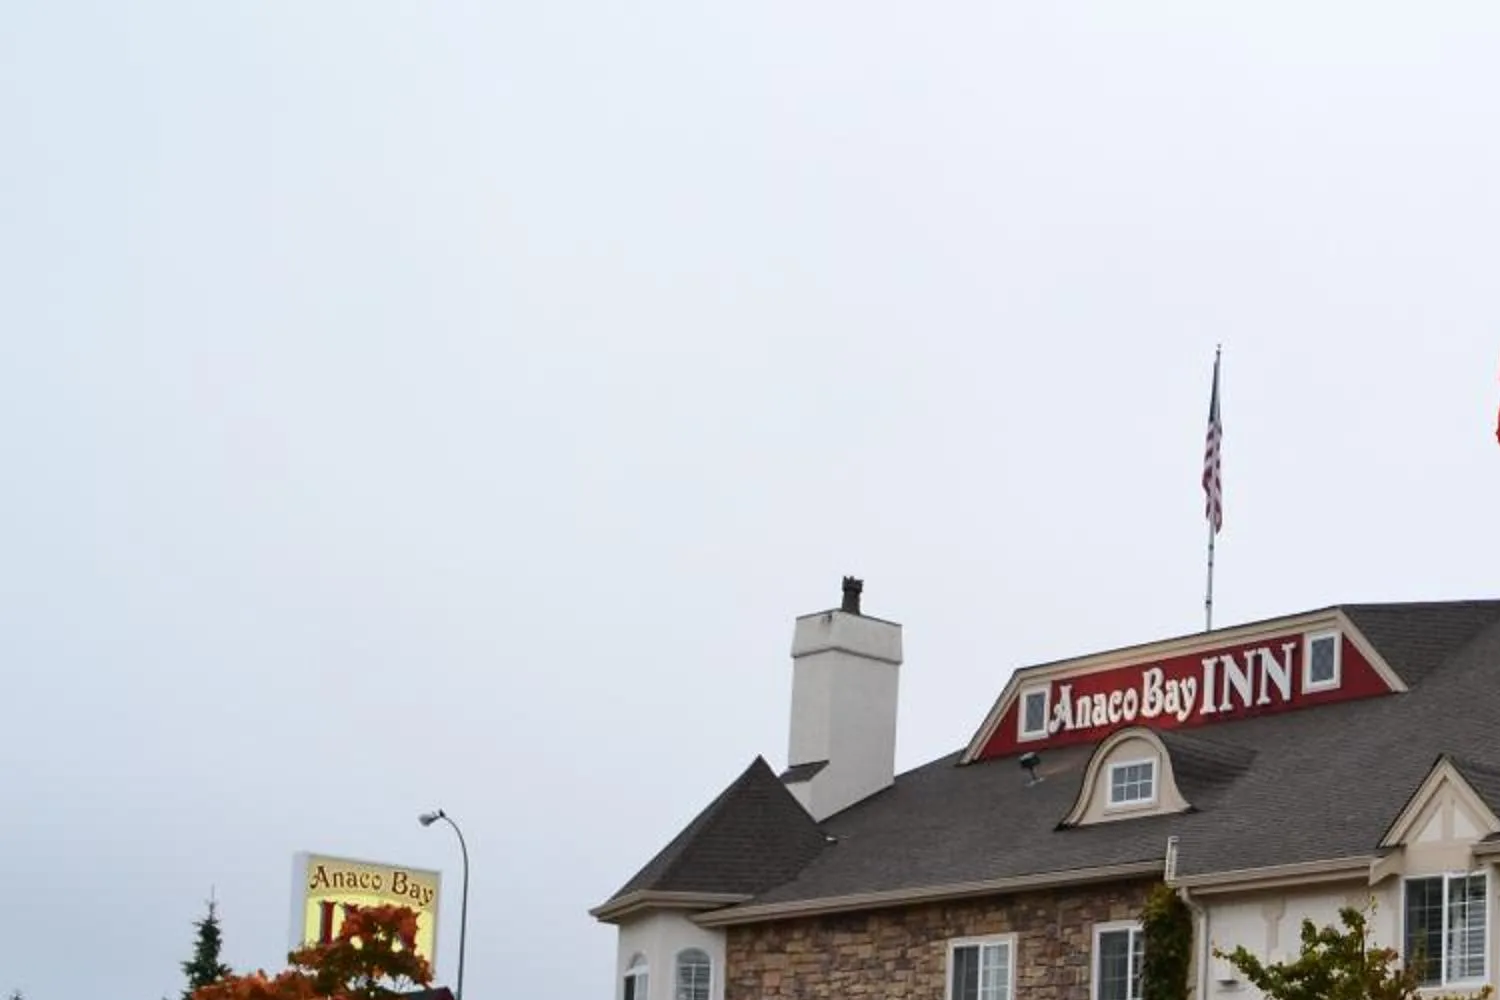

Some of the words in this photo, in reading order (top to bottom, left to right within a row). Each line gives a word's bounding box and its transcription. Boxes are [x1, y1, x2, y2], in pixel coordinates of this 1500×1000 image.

[1050, 683, 1139, 733] Anaco
[1141, 667, 1197, 723] Bay
[1200, 642, 1297, 715] INN
[310, 865, 383, 890] Anaco
[391, 871, 435, 907] Bay
